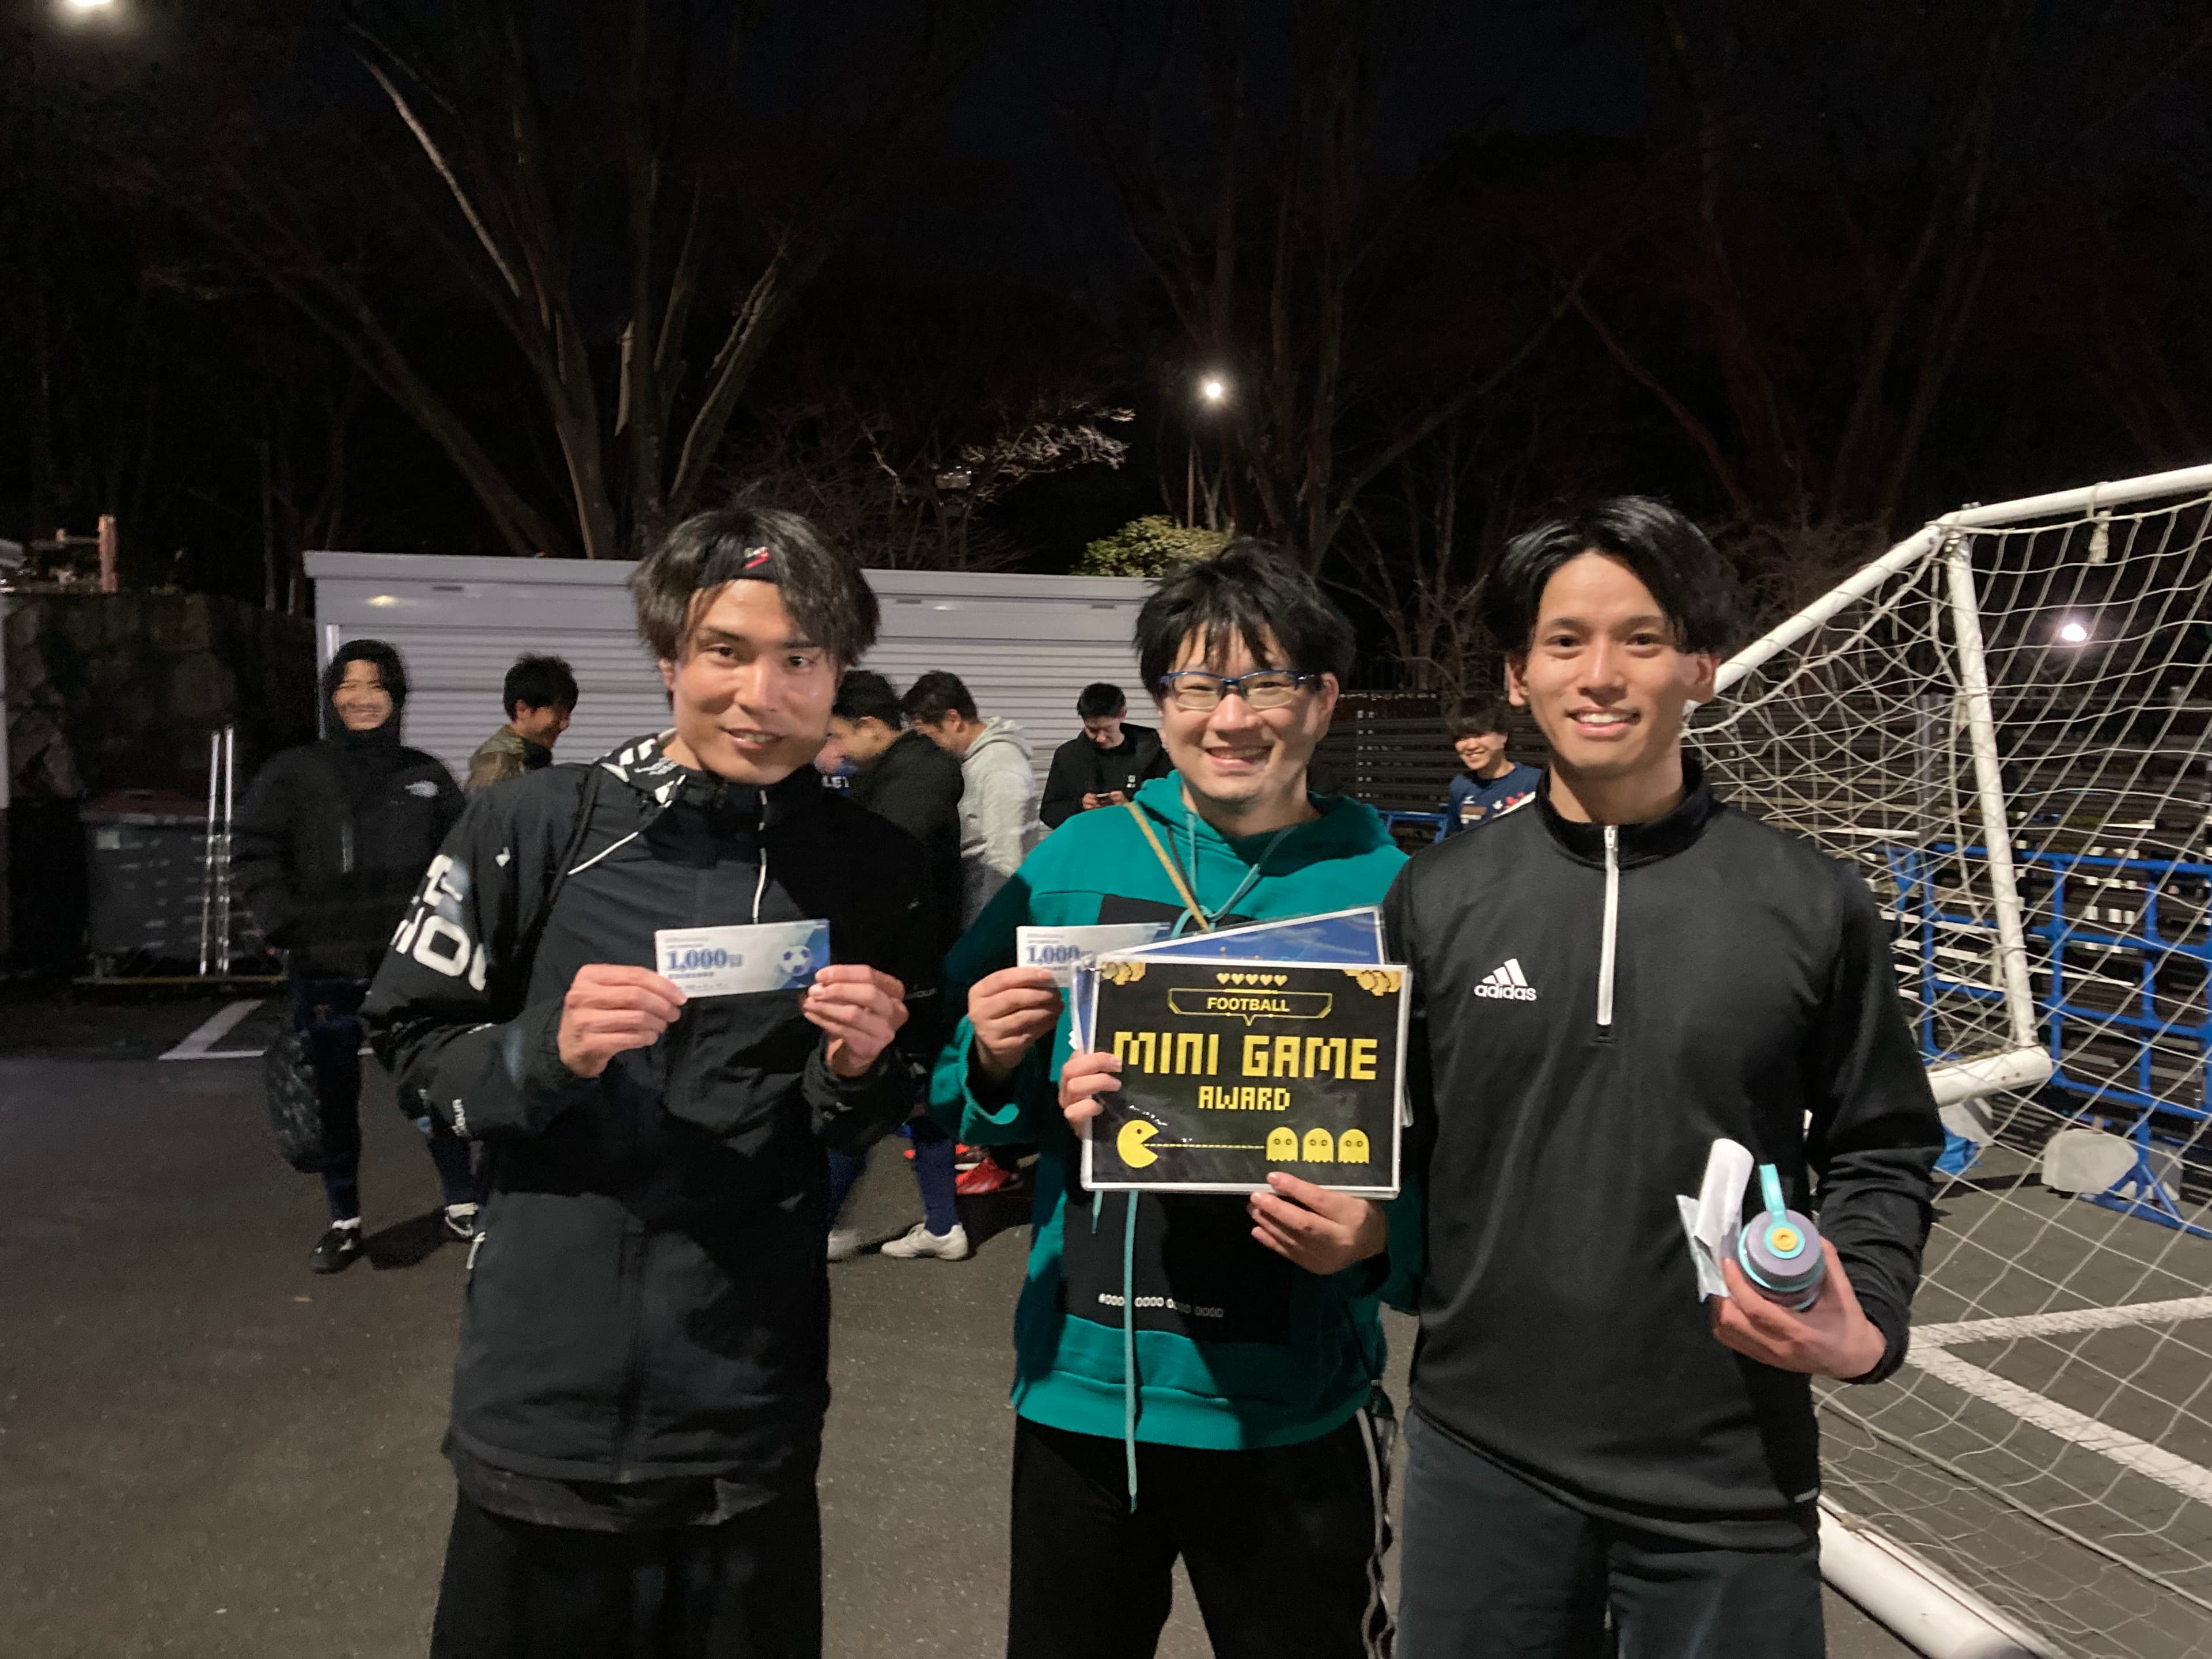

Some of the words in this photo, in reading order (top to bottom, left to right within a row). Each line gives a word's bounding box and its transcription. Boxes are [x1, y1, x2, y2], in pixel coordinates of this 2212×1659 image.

[1027, 945, 1092, 965] 1,000
[1474, 983, 1537, 1001] adidas
[1207, 997, 1290, 1012] FOOTBALL
[1113, 1032, 1219, 1075] MINI
[1242, 1035, 1377, 1080] GAME
[1198, 1085, 1290, 1111] AWARD
